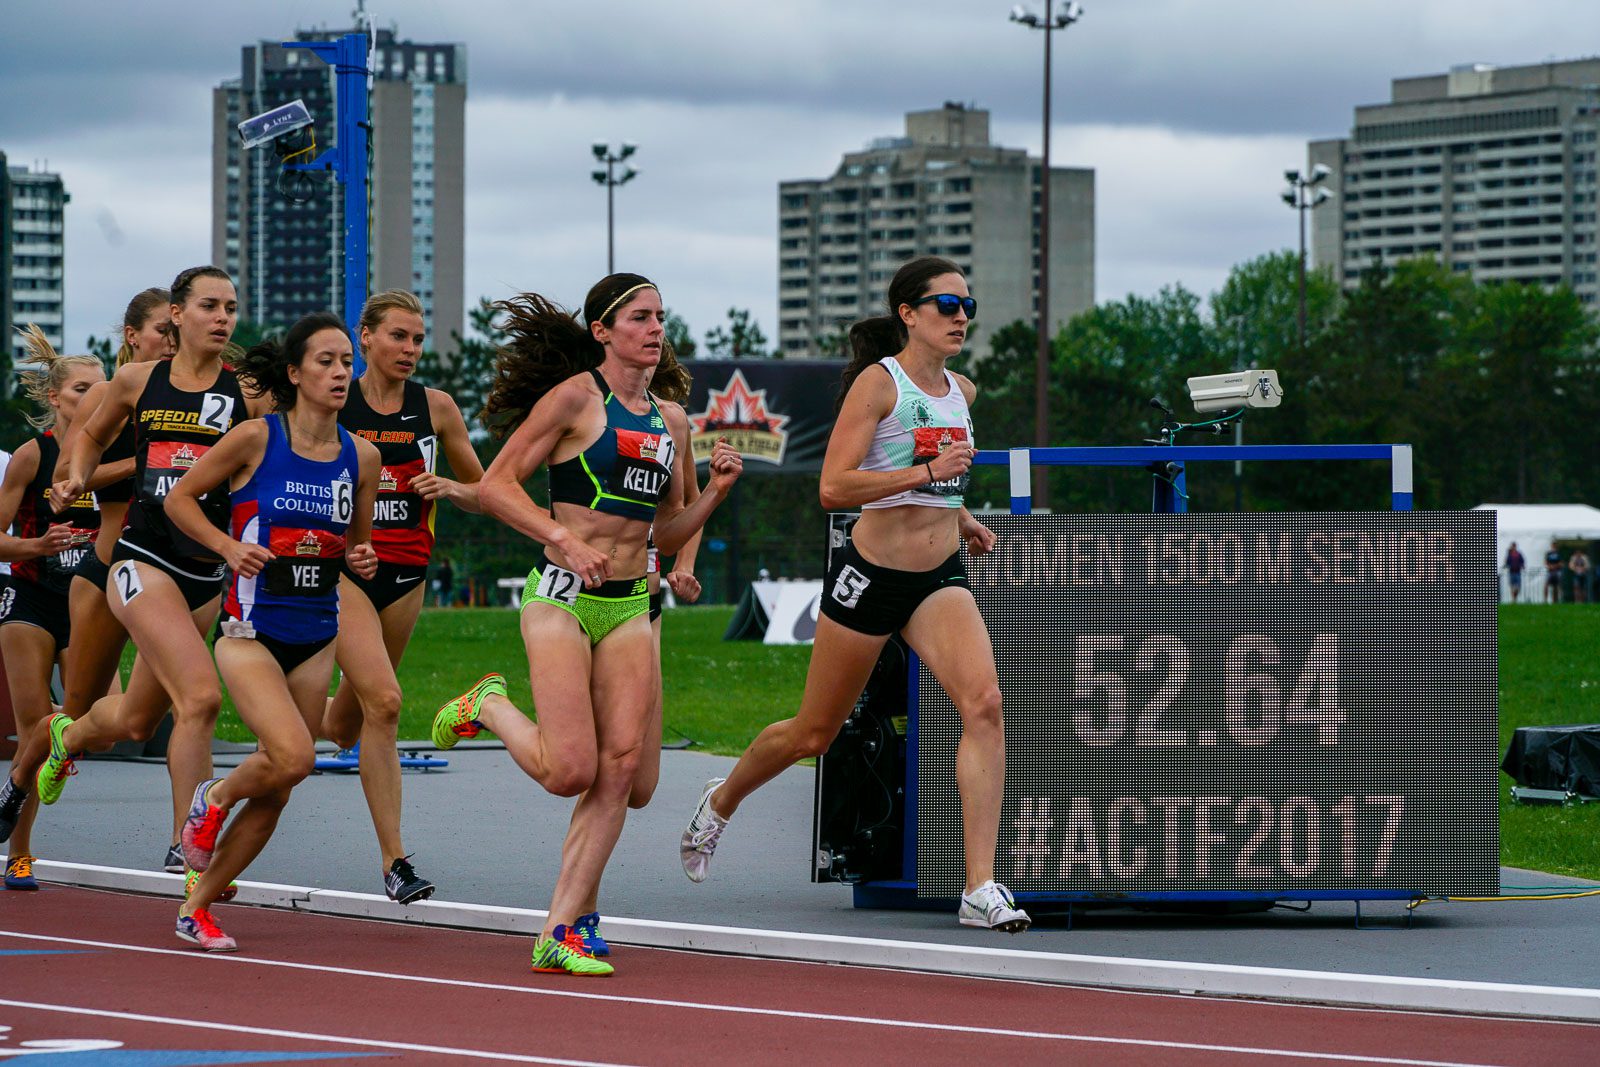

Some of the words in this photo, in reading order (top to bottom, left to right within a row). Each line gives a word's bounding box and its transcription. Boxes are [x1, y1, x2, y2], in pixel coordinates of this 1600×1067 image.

[205, 395, 226, 429] 2
[422, 438, 434, 473] 7
[285, 481, 333, 499] BRITIS
[623, 466, 668, 495] KELLY
[273, 497, 335, 517] COLUM
[338, 484, 351, 521] 6
[372, 500, 409, 521] ONES
[1140, 532, 1244, 585] 1500
[1255, 532, 1292, 585] M
[1304, 530, 1456, 584] SENIOR
[118, 566, 138, 601] 2
[292, 565, 320, 587] YEE
[547, 568, 575, 602] 12
[836, 569, 863, 603] 5
[1072, 633, 1347, 746] 52.64
[1010, 794, 1405, 880] #ACTF2017
